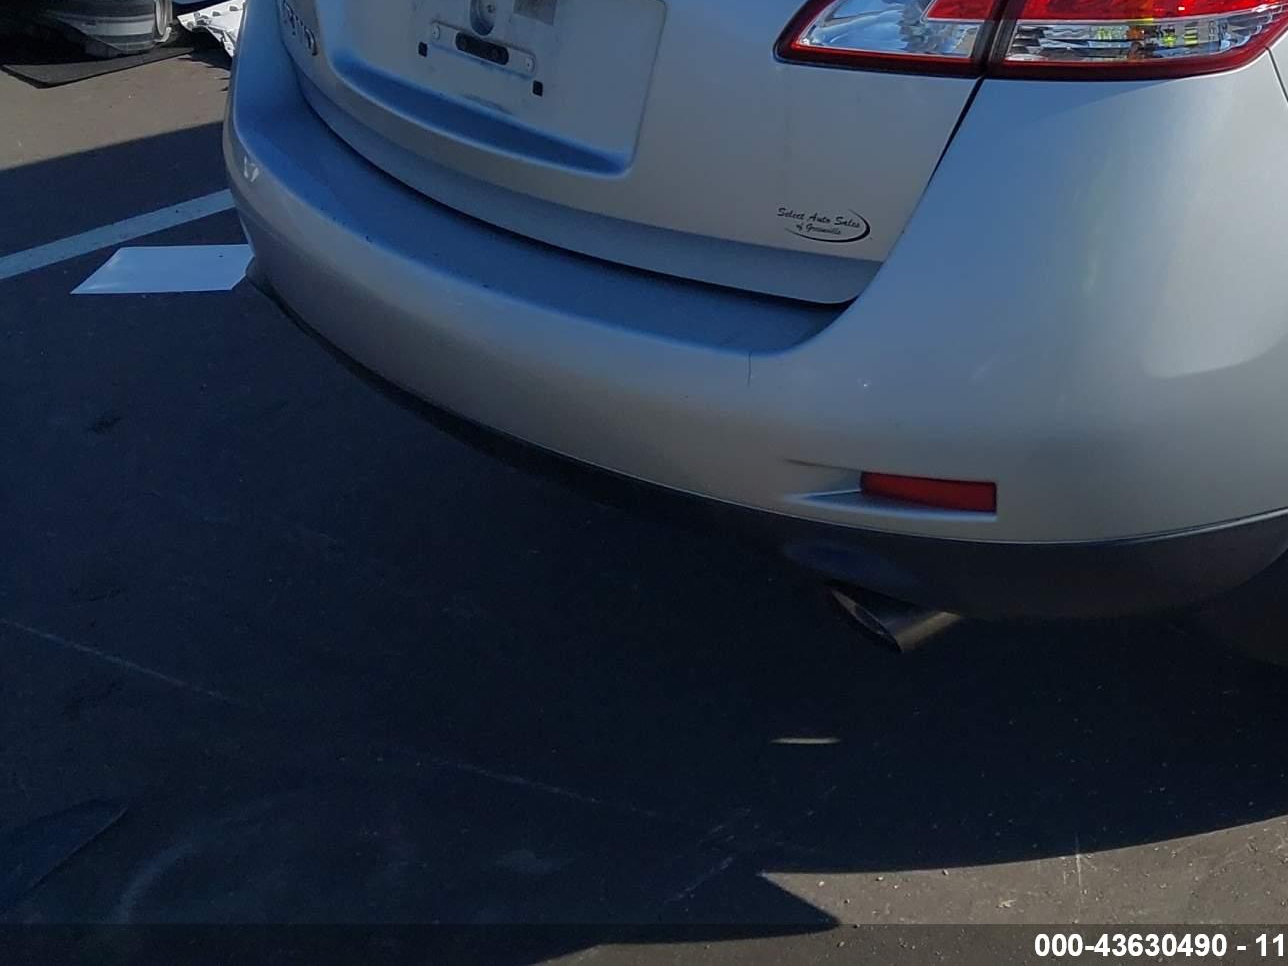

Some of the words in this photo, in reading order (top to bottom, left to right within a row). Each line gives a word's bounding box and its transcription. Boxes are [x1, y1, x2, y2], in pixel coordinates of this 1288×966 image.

[777, 207, 805, 220] Select
[807, 212, 831, 224] Auto
[834, 216, 860, 228] Sales
